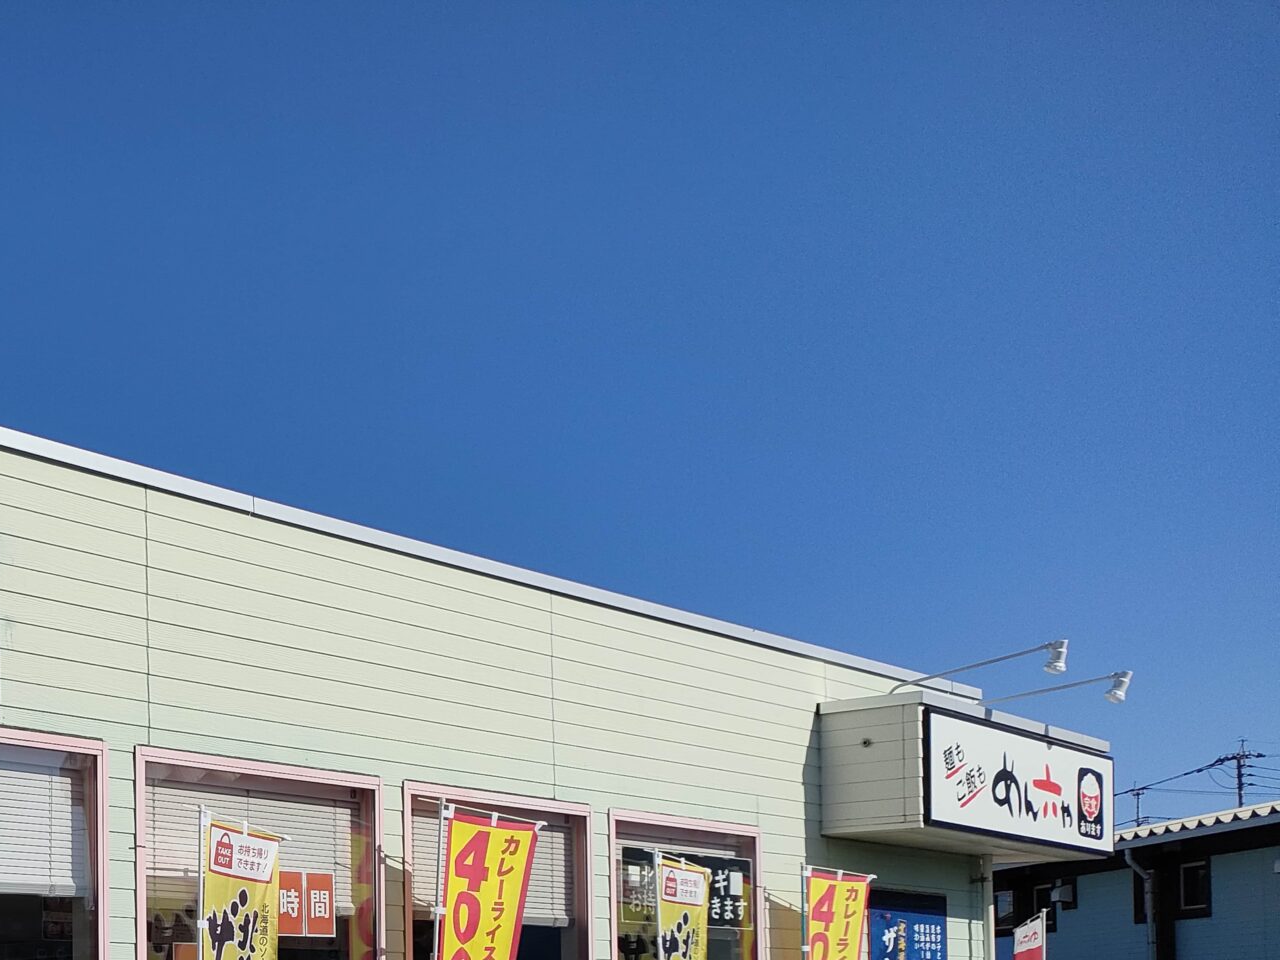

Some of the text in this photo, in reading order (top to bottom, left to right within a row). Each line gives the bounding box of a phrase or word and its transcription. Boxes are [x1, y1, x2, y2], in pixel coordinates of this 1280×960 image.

[943, 742, 965, 774] 麺も
[957, 765, 986, 802] ご飯も
[992, 751, 1073, 829] めん六や
[1080, 820, 1102, 838] あります
[217, 856, 229, 864] OUT
[218, 847, 231, 857] TAKE
[237, 844, 269, 860] お持ち帰り
[279, 889, 329, 919] 時間
